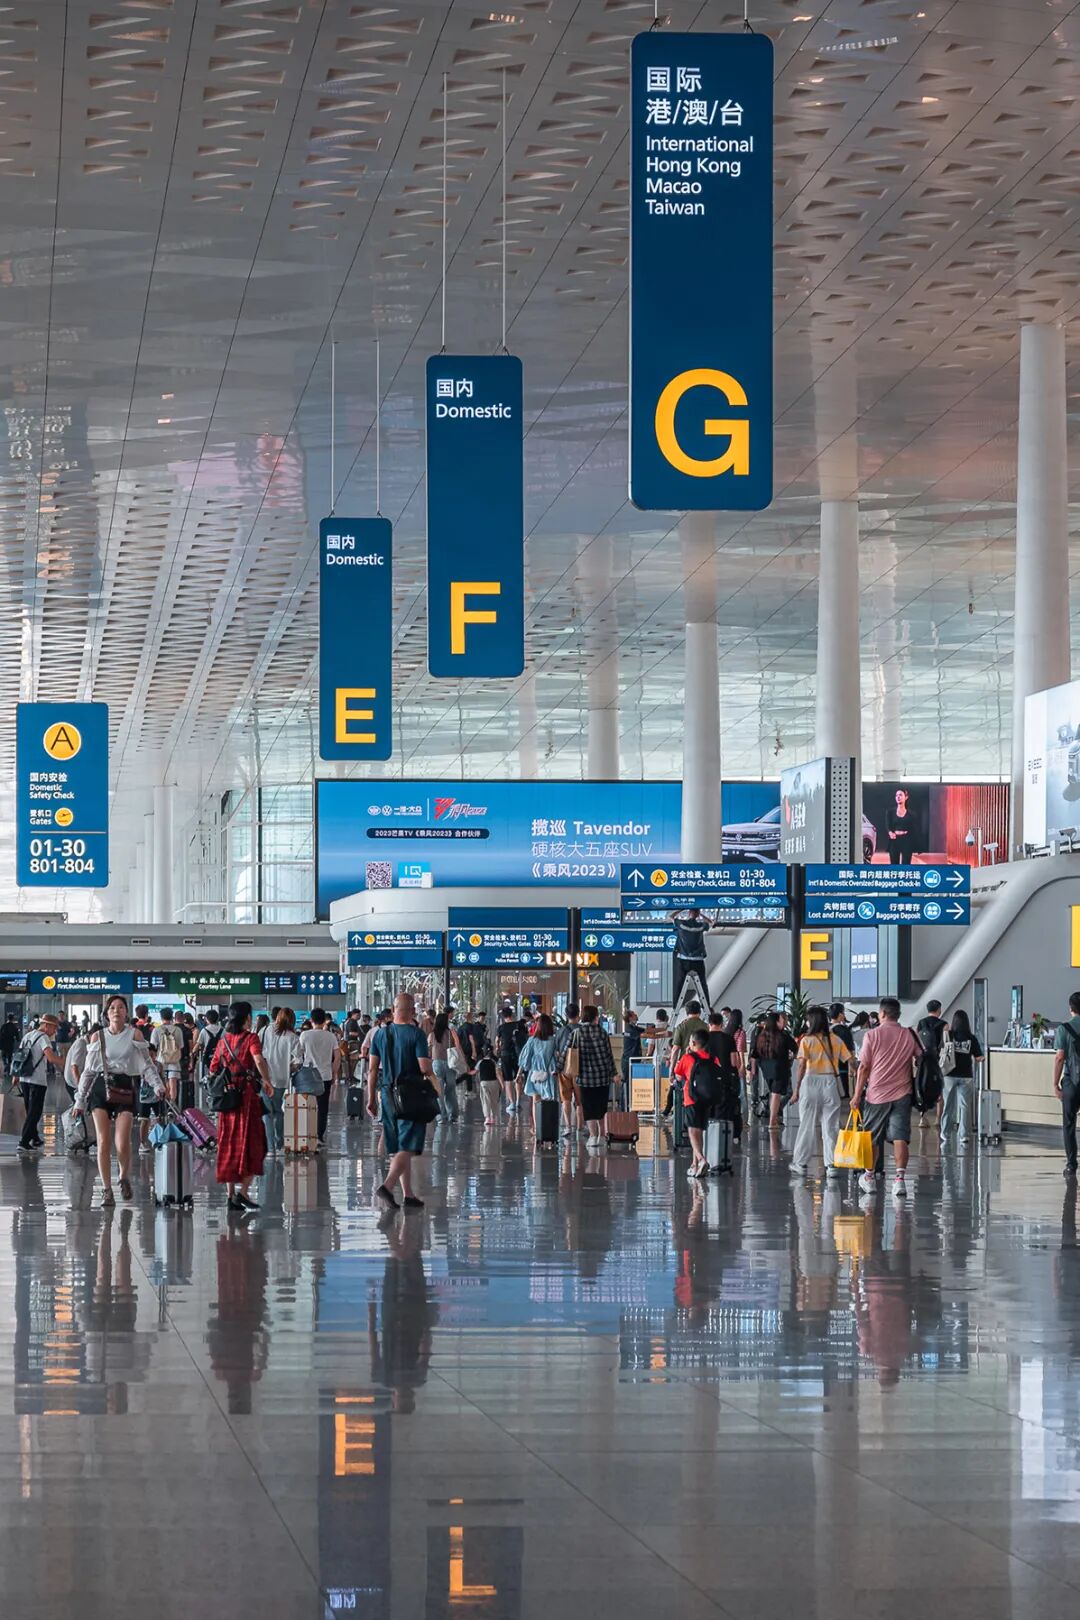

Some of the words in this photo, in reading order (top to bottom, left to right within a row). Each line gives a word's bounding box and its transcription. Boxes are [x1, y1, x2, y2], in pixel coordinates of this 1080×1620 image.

[646, 66, 702, 92] 国际
[645, 98, 744, 125] 港/澳/台
[646, 135, 754, 152] International
[646, 157, 691, 176] Hong
[697, 158, 741, 177] Kong
[646, 178, 702, 194] Macao
[645, 199, 705, 215] Taiwan
[436, 379, 474, 398] 国内
[436, 403, 512, 419] Domestic
[655, 368, 750, 477] G
[326, 534, 355, 550] 国内
[326, 553, 384, 565] Domestic
[451, 582, 501, 654] F
[335, 688, 376, 743] E
[50, 726, 75, 751] A
[30, 772, 68, 782] 国内安检
[29, 792, 52, 800] Safety
[531, 818, 567, 837] 揽巡
[573, 820, 651, 836] Tavendor
[30, 839, 85, 857] 01-30
[531, 840, 653, 858] 硬核大五座SUV
[30, 858, 95, 874] 801-804
[532, 862, 616, 878] 《乘风2023》
[739, 869, 765, 878] 01-30
[670, 879, 697, 888] Security
[718, 879, 736, 887] Gates
[739, 878, 776, 888] 801-804
[824, 879, 848, 887] Domestic
[875, 880, 898, 888] Baggage
[808, 911, 821, 919] Lost
[822, 911, 834, 919] and
[835, 911, 855, 919] Found
[876, 912, 899, 920] Baggage
[900, 912, 921, 920] Deposit
[533, 933, 552, 941] 01-30
[801, 933, 829, 979] E
